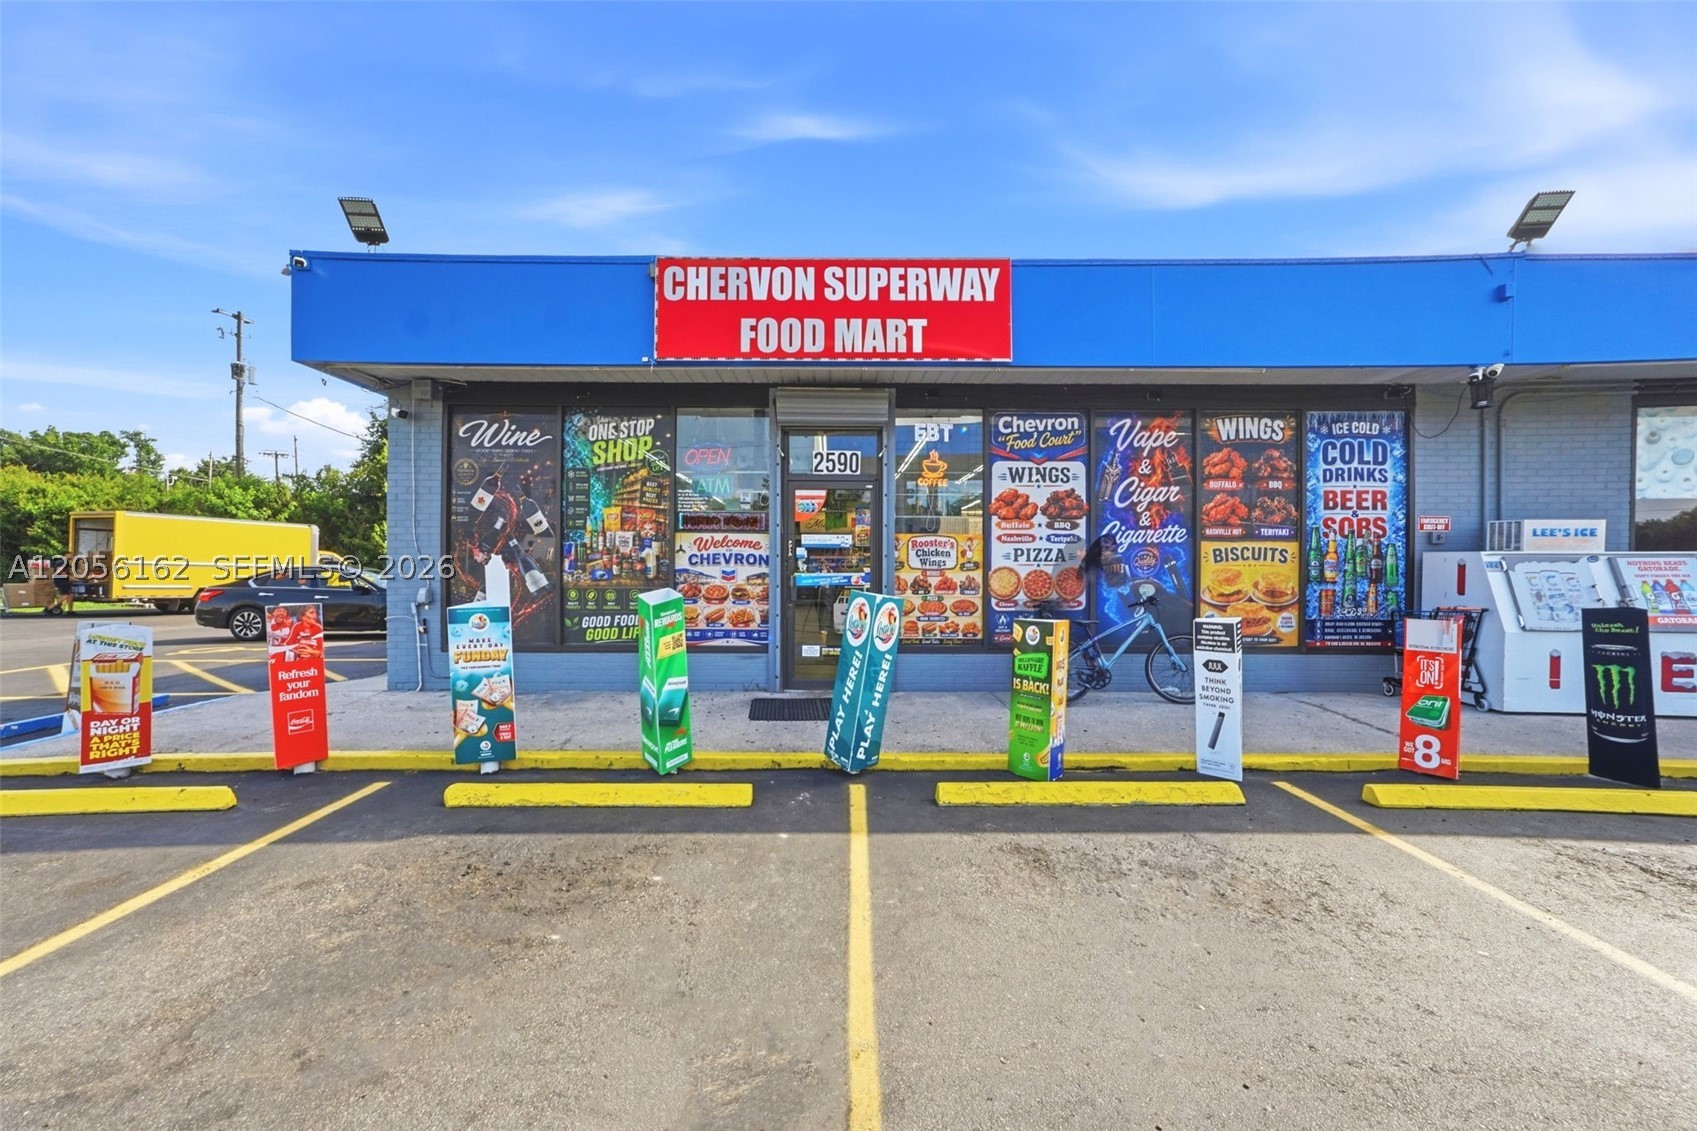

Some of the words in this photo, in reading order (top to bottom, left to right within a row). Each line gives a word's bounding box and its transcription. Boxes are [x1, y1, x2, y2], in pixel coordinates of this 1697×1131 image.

[663, 266, 815, 301] CHERVON
[824, 266, 1000, 301] SUPERWAY
[740, 318, 825, 353] FOOD
[835, 318, 928, 353] MART
[588, 421, 617, 442] ONE
[620, 418, 655, 439] STOP
[914, 423, 954, 442] EBT
[998, 416, 1079, 434] Chevron
[1216, 418, 1285, 441] WINGS
[1332, 422, 1350, 435] ICE
[1351, 421, 1380, 434] COLD
[458, 419, 553, 447] Wine
[1109, 418, 1178, 457] Vape
[592, 435, 653, 465] SHOP
[685, 447, 732, 465] OPEN
[1321, 439, 1389, 466] COLD
[814, 452, 860, 474] 2590
[1138, 459, 1152, 474] &
[1008, 467, 1071, 484] WINGS
[1322, 467, 1389, 483] DRINKS
[696, 478, 730, 494] ATM
[918, 478, 949, 488] COFFEE
[1268, 481, 1283, 489] BBQ
[1114, 476, 1181, 512] Cigar
[1322, 490, 1388, 511] BEER
[1139, 511, 1152, 526] &
[1350, 510, 1360, 518] &
[1260, 528, 1290, 536] TERIYAKI
[1532, 528, 1572, 538] LEE'S
[1574, 528, 1598, 538] ICE
[693, 535, 763, 553] Welcome
[911, 540, 955, 550] Rooster's
[688, 553, 769, 567] CHEVRON
[915, 548, 952, 558] Chicken
[1012, 548, 1067, 562] PIZZA
[1212, 546, 1289, 564] BISCUITS
[920, 558, 947, 568] Wings
[582, 616, 611, 628] GOOD
[654, 612, 683, 628] REWARDS
[586, 628, 619, 640] GOOD
[622, 626, 640, 639] LIF
[100, 640, 118, 648] THIS
[454, 649, 508, 664] FUNDAY
[278, 666, 318, 680] Refresh
[1018, 664, 1044, 674] RAFFLE
[287, 680, 311, 692] your
[1012, 678, 1022, 690] IS
[1022, 679, 1050, 695] BACK!
[1204, 676, 1226, 686] THINK
[279, 689, 319, 702] fandom
[1201, 684, 1232, 694] BEYOND
[1199, 693, 1234, 704] SMOKING
[90, 718, 118, 728] DAY
[120, 716, 140, 724] OR
[1590, 708, 1648, 722] MONSTER
[90, 724, 140, 736] NIGHT
[828, 703, 846, 751] PLAY
[90, 736, 101, 744] A
[104, 732, 140, 742] PRICE
[856, 711, 876, 760] PLAY
[90, 738, 140, 750] THAT'S
[1414, 734, 1441, 768] 8
[89, 745, 140, 760] RIGHT
